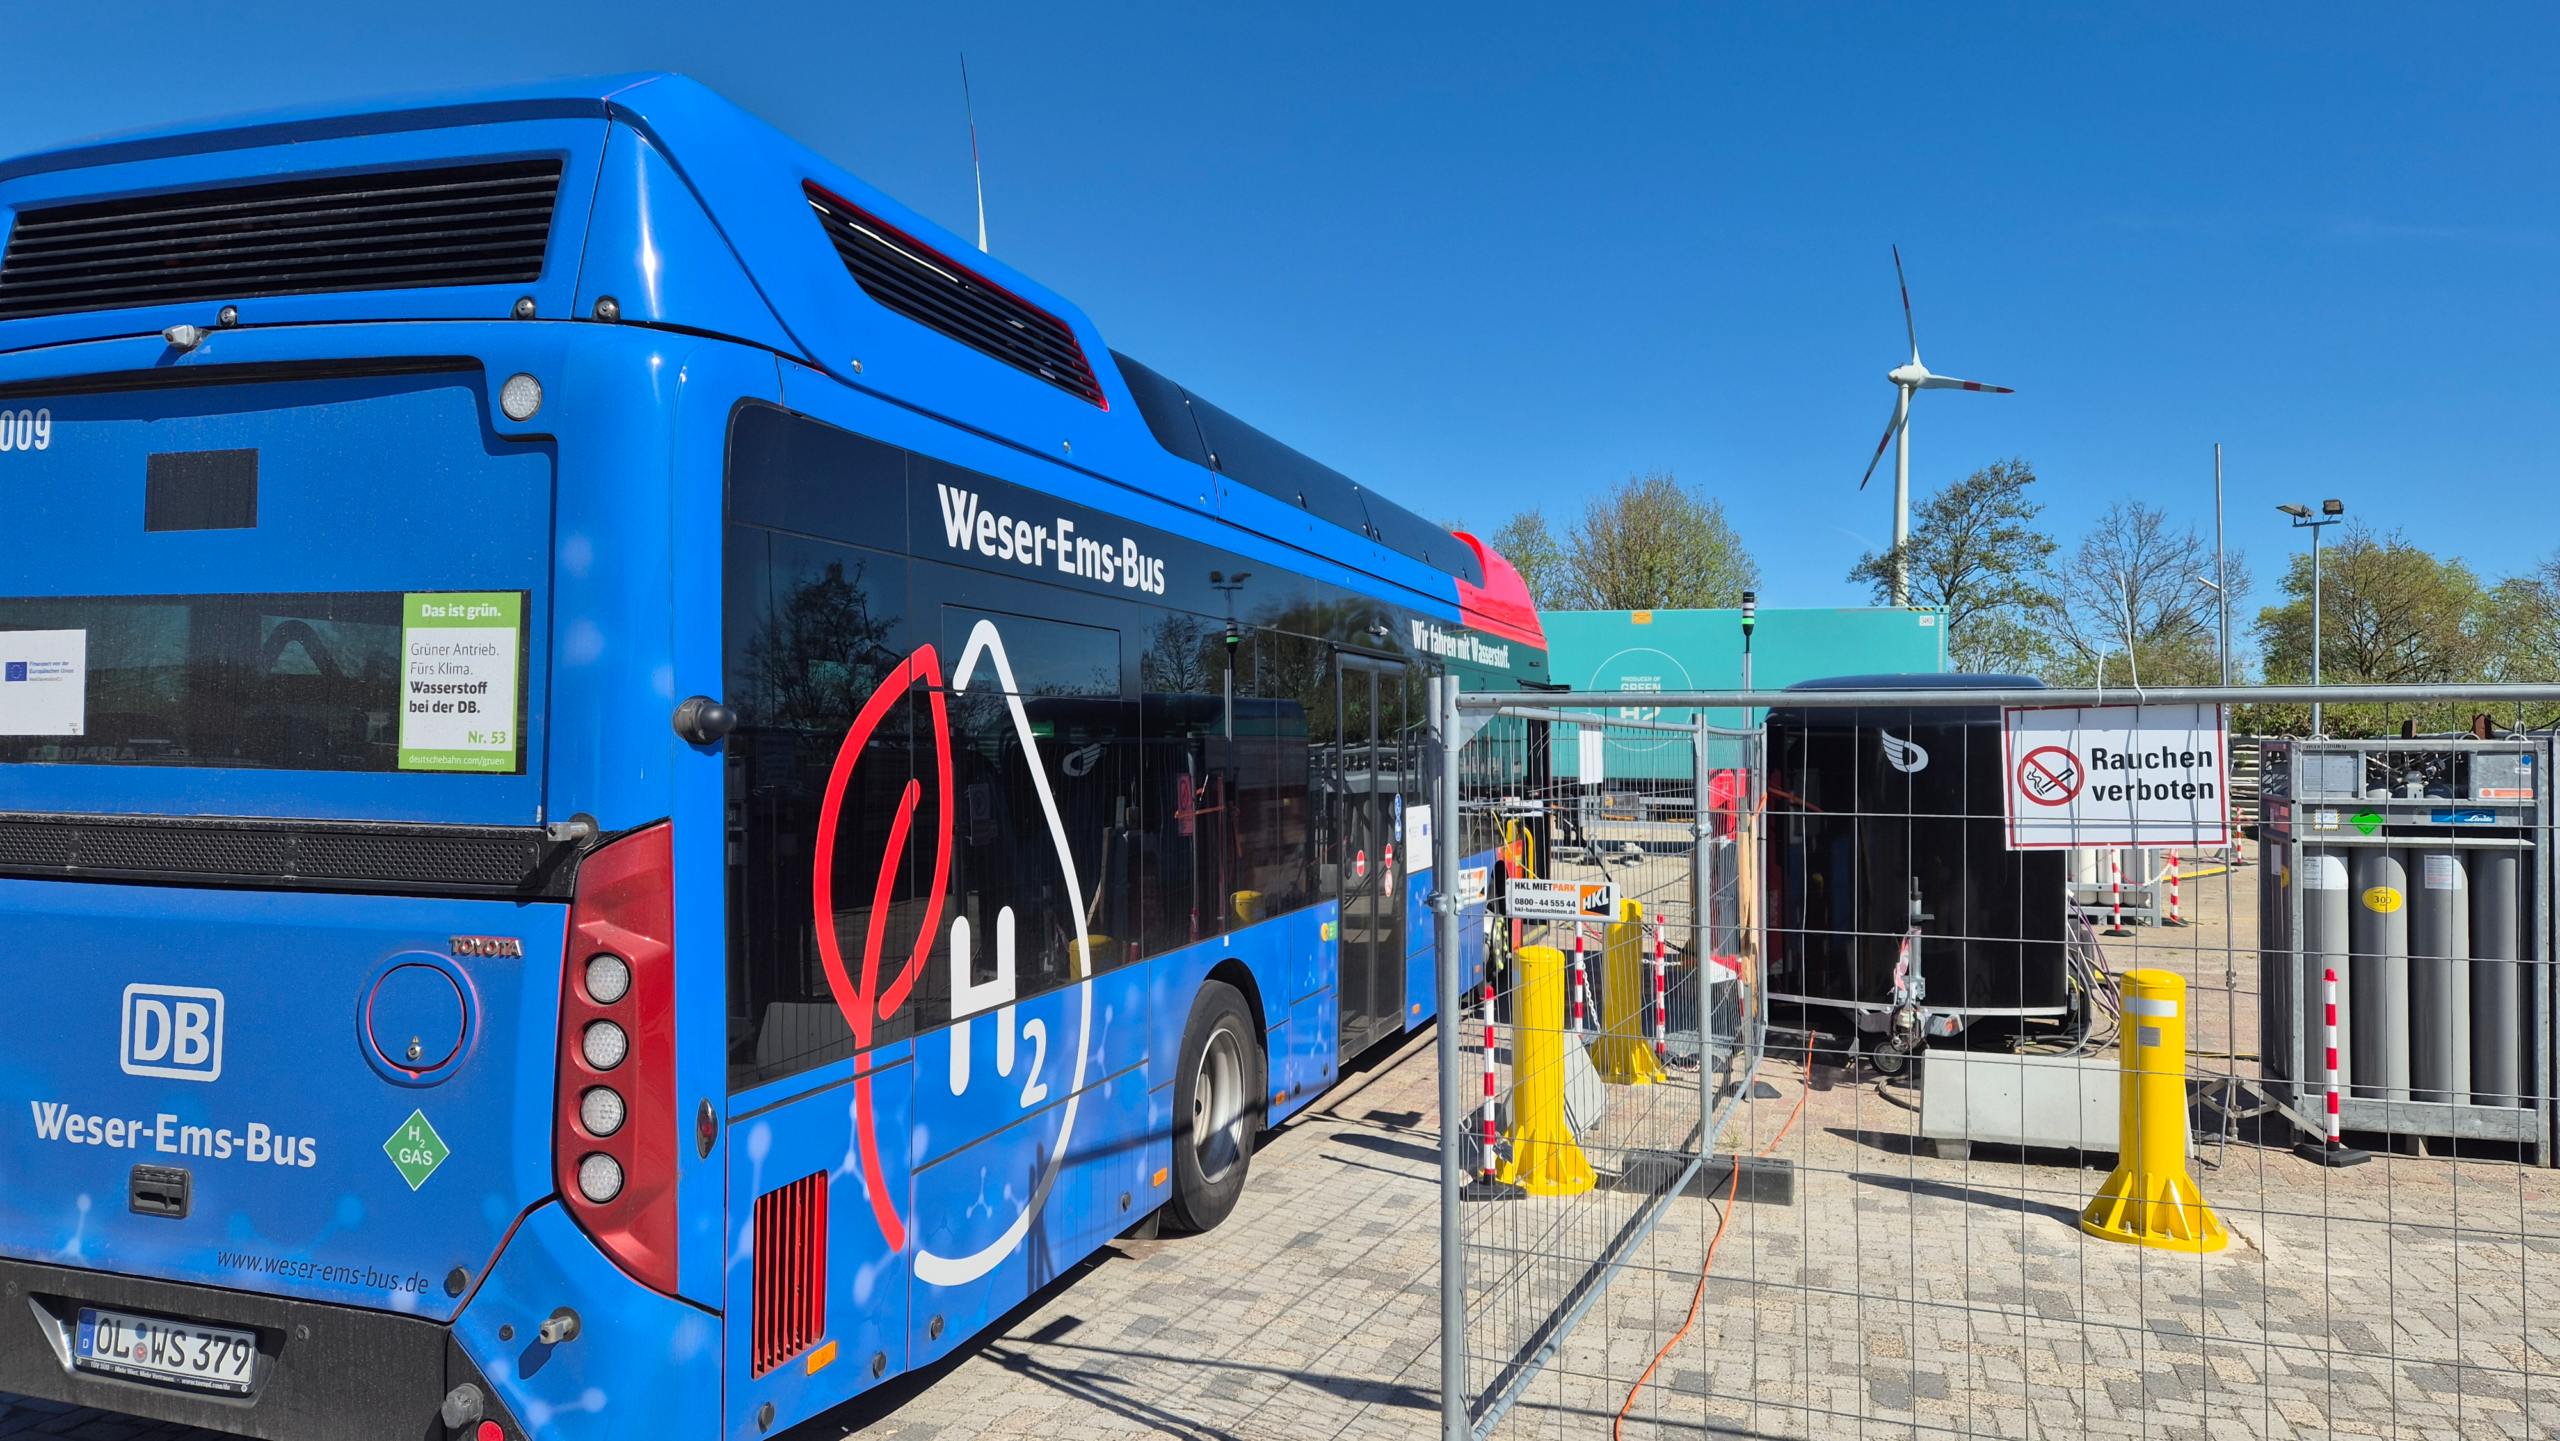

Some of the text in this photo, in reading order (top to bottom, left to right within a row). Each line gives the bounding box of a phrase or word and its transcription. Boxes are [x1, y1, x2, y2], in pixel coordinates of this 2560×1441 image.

[0, 408, 51, 451] 009
[937, 483, 1165, 595] Weser-Ems-Bus
[421, 603, 502, 620] Das ist grün.
[410, 643, 500, 656] Grüner Antrieb.
[1411, 619, 1511, 669] Wir fahren mit Wasserstoff.
[410, 661, 473, 675] Fürs Klima.
[410, 681, 488, 695] Wasserstoff
[1620, 683, 1661, 693] GREEN
[409, 700, 481, 714] bei der DB.
[467, 731, 507, 744] Nr. 53
[409, 755, 505, 767] deutschebahn.com/gruen
[2091, 745, 2213, 770] Rauchen
[2092, 778, 2214, 802] verboten
[2464, 814, 2493, 823] Linde
[1514, 882, 1576, 892] HKL MIETPARK
[1514, 898, 1534, 906] 0800
[1550, 899, 1565, 907] 555
[1566, 900, 1576, 908] 44
[1582, 886, 1609, 911] HKL
[2374, 895, 2392, 904] 300
[1514, 906, 1576, 915] hkl-baumaschinen.de
[449, 937, 523, 957] TOYOTA
[133, 998, 210, 1065] DB
[30, 1100, 317, 1168] Weser-Ems-Bus
[399, 1148, 433, 1166] GAS
[217, 1251, 430, 1295] www.weser-ems-bus.de
[95, 1317, 250, 1376] OL WS 379
